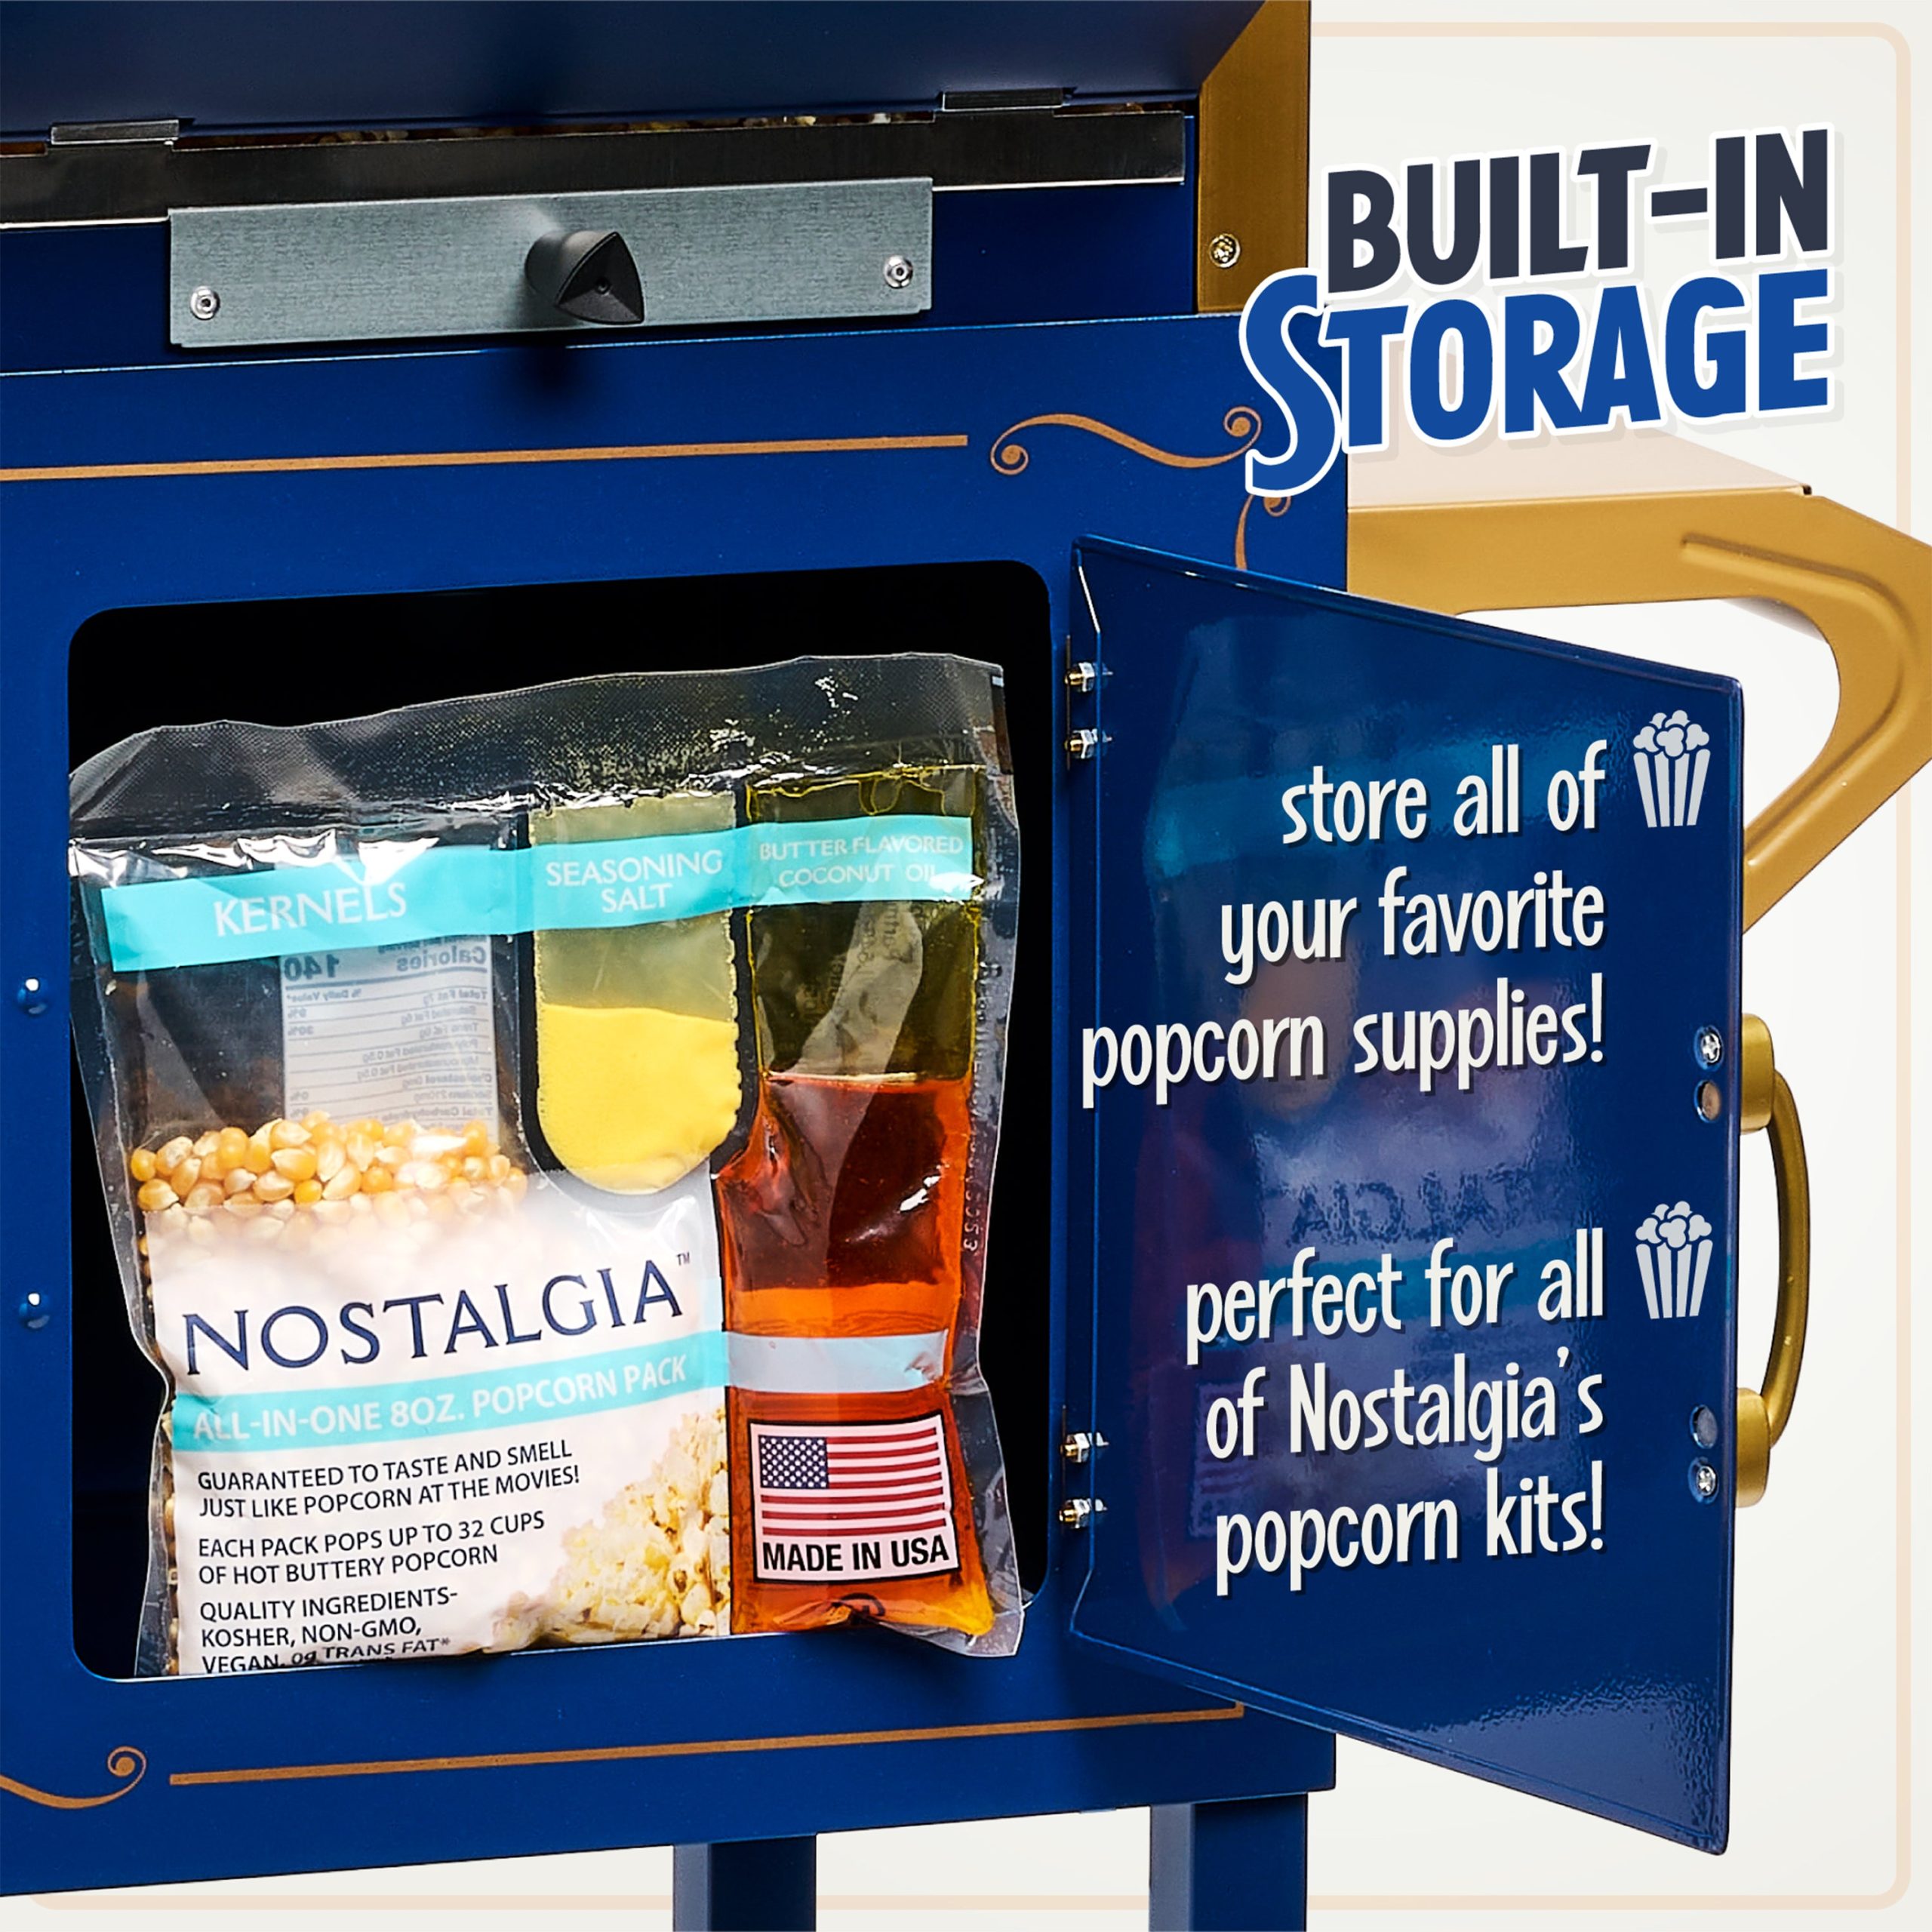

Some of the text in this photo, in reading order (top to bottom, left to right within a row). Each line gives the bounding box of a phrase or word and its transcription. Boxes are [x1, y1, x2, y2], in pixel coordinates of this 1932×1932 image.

[760, 835, 963, 860] BUTTER FLAVORED
[546, 851, 721, 888] SEASONING
[780, 863, 936, 887] COCONUT OIL
[214, 882, 406, 936] KERNELS
[601, 884, 670, 912] SALT
[183, 1260, 682, 1375] NOSTALGIA
[196, 1354, 688, 1440] ALL-IN-ONE 8OZ. POPCORN PACK
[198, 1439, 571, 1490] GUARANTEED TO TASTE AND SMELL
[200, 1466, 578, 1517] JUST LIKE POPCORN AT THE MOVIES!
[200, 1511, 543, 1557] EACH PACK POPS UP TO 32 CUPS
[199, 1545, 497, 1584] OF HOT BUTTERY POPCORN
[763, 1535, 949, 1571] MADE IN USA
[201, 1587, 457, 1622] QUALITY INGREDIENTS-
[202, 1617, 422, 1648] KOSHER, NON-GMO,
[324, 1641, 396, 1660] TRANS
